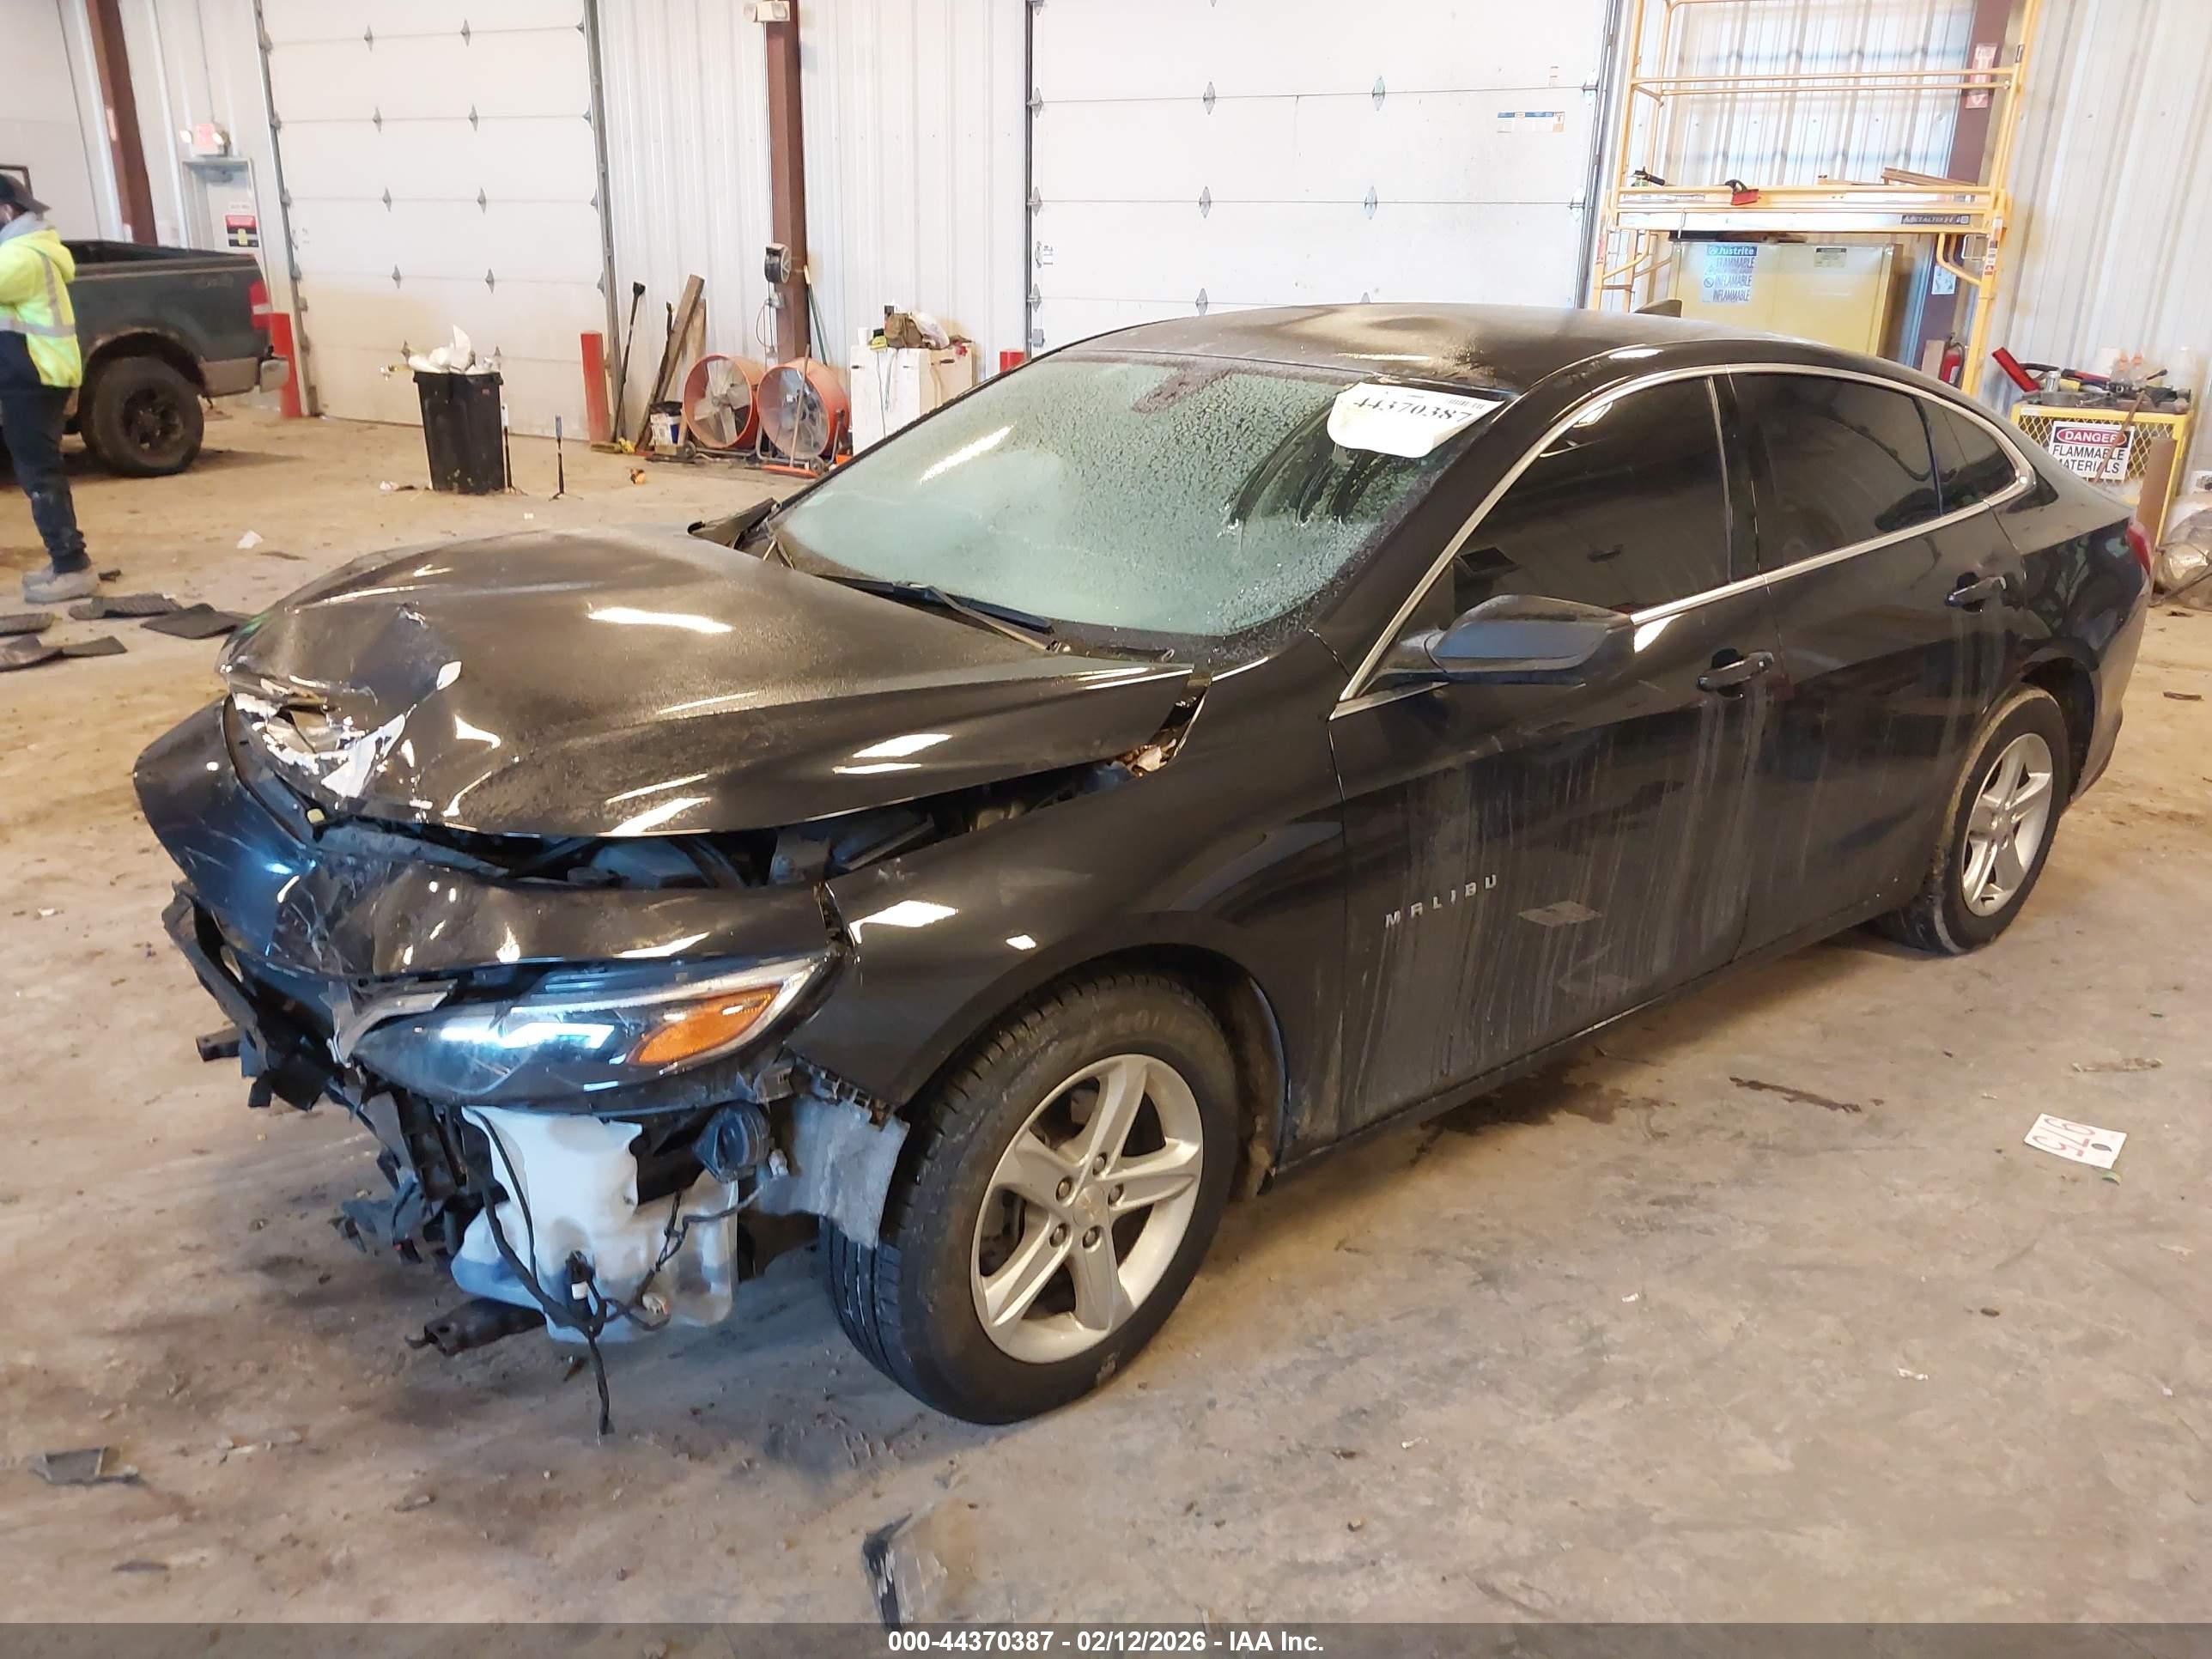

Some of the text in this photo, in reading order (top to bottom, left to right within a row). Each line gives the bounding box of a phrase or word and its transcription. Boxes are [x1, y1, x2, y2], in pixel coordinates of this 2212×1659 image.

[1717, 246, 1754, 255] Justrite
[1353, 397, 1474, 422] 44370387
[2058, 459, 2120, 474] ATERILS
[1384, 874, 1498, 928] MALIBU
